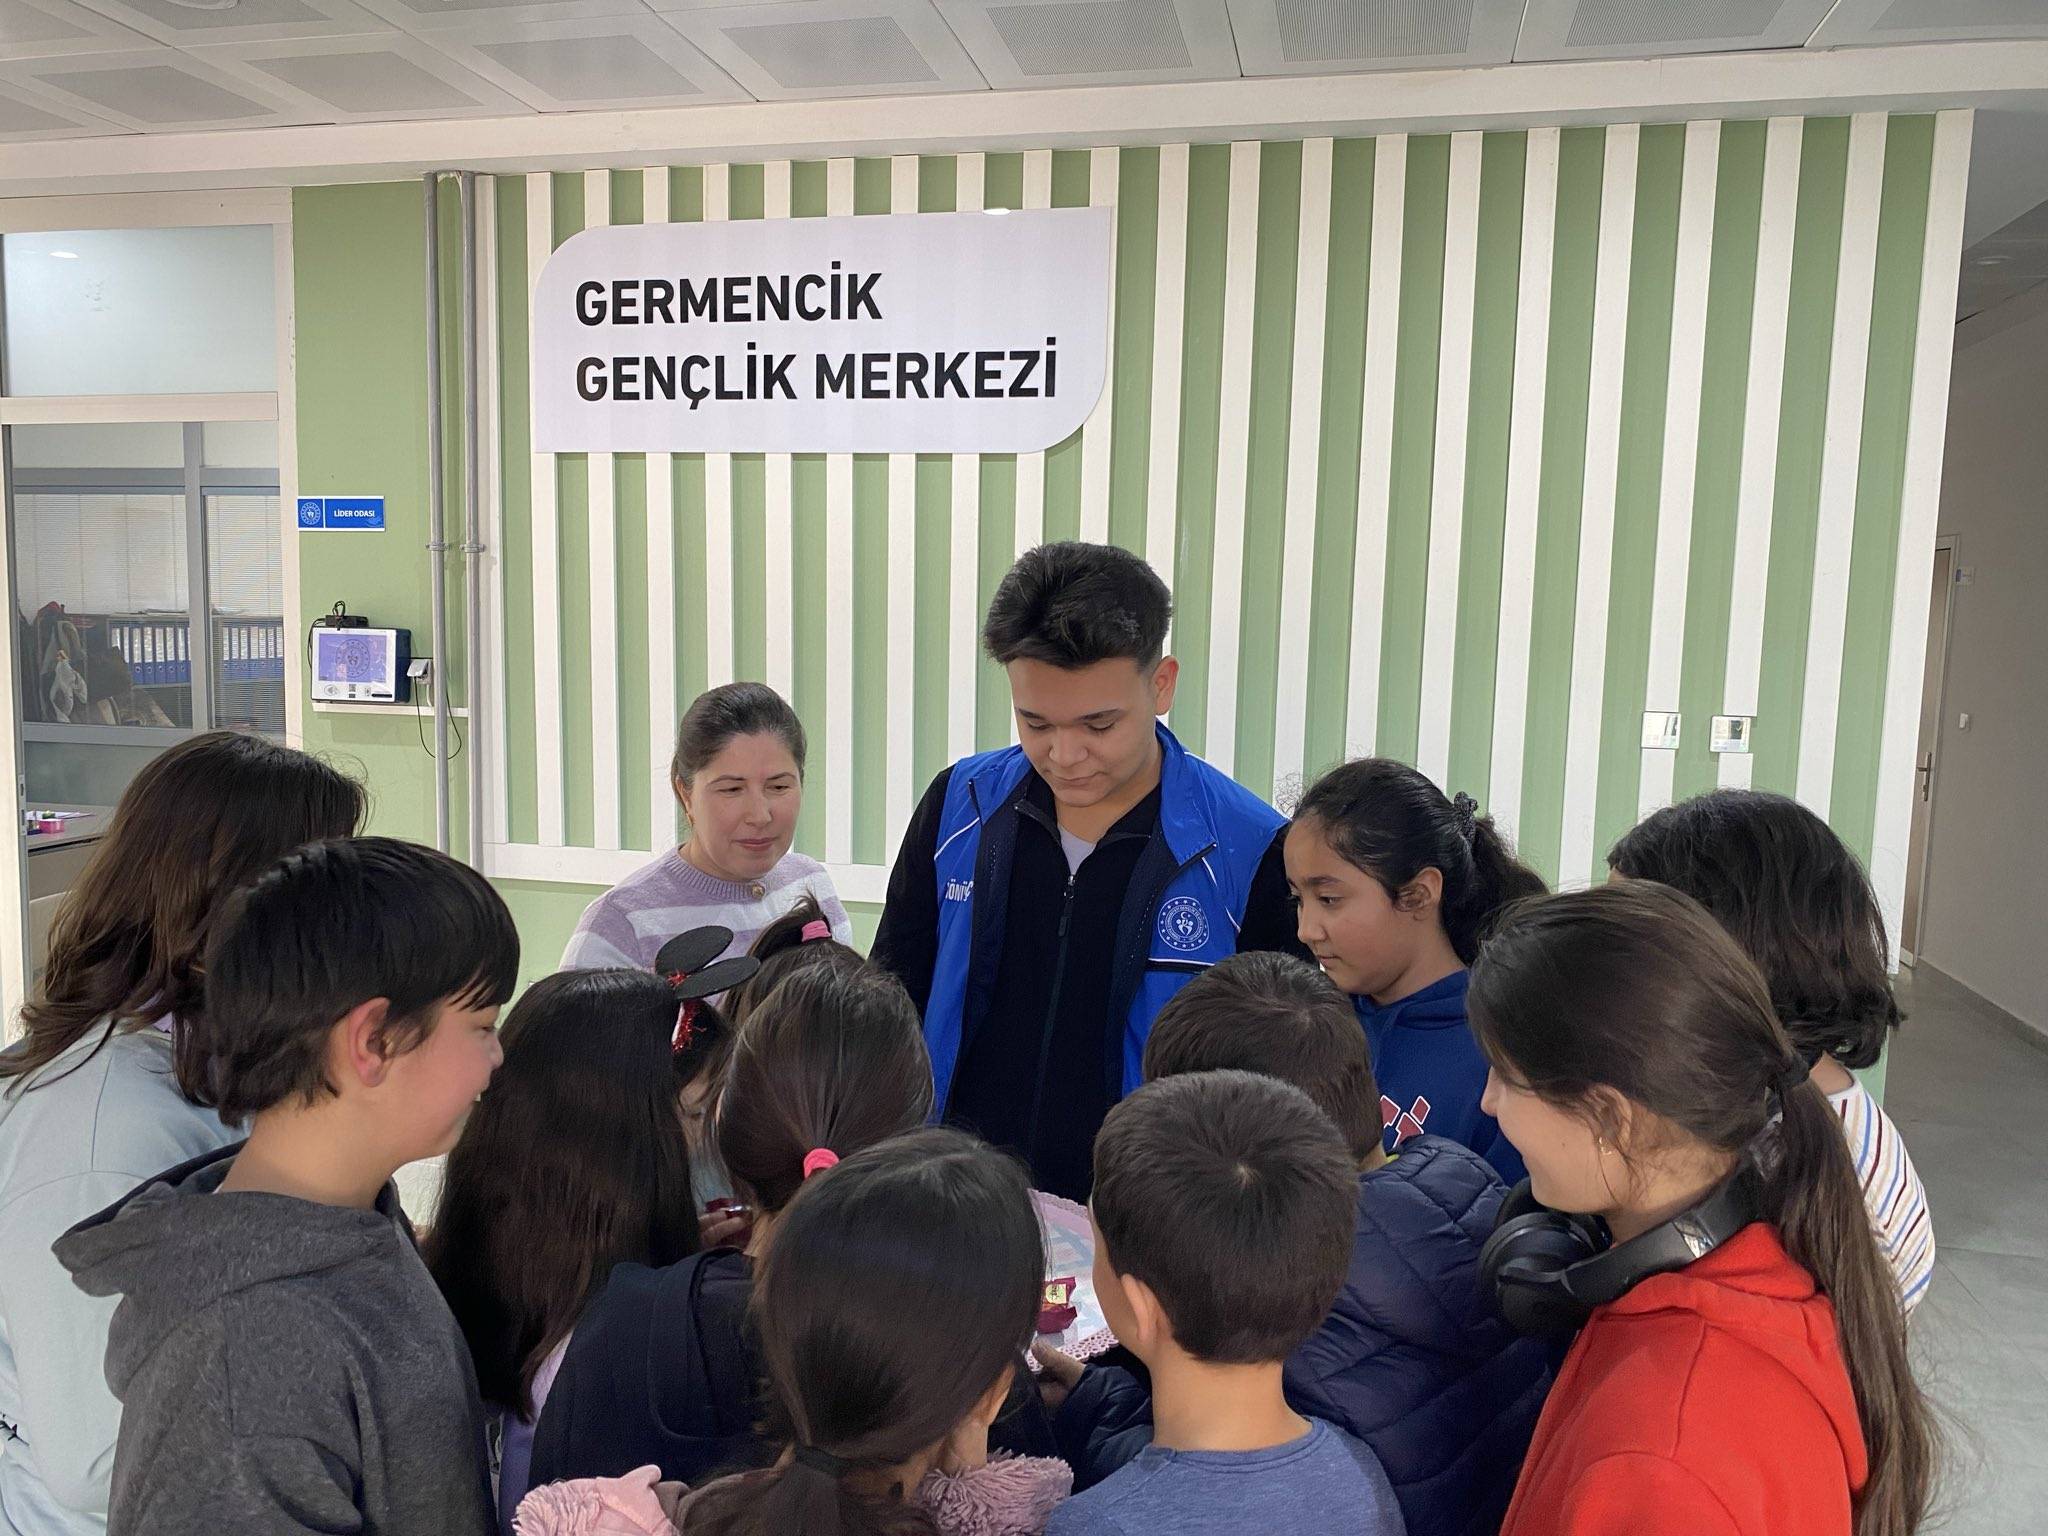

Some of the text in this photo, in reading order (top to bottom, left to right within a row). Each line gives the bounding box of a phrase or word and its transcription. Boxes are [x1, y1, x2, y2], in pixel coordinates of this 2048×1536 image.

[576, 261, 882, 326] GERMENCİK
[576, 336, 1057, 410] GENÇLİK MERKEZİ
[333, 508, 376, 518] LİDER ODASI
